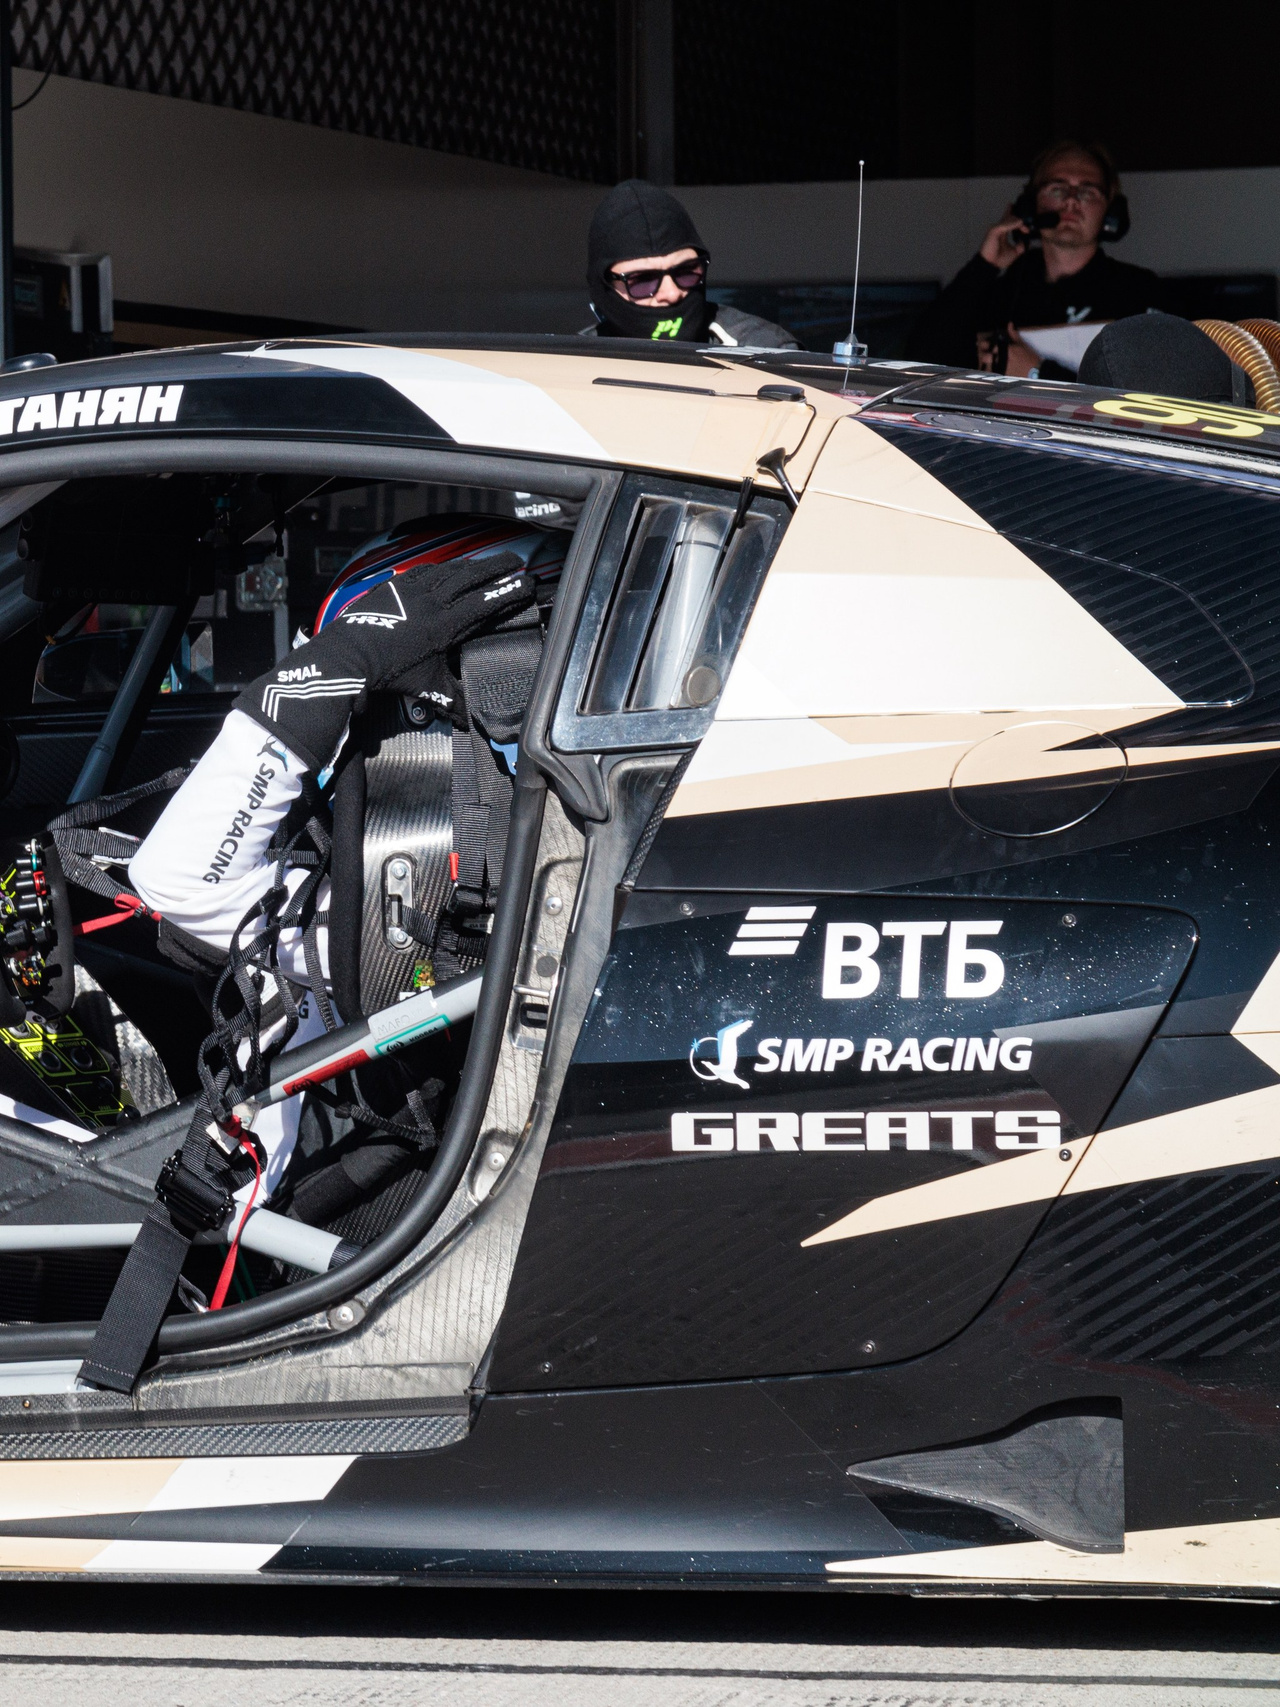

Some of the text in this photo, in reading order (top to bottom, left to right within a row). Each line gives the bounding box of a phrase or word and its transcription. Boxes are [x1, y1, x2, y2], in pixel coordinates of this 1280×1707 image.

[346, 616, 399, 629] HRX
[277, 664, 322, 682] SMAL
[202, 762, 276, 885] SMP RACING
[822, 920, 1006, 999] ВТБ
[753, 1037, 1033, 1073] SMP RACING
[671, 1110, 1061, 1152] GREATS
